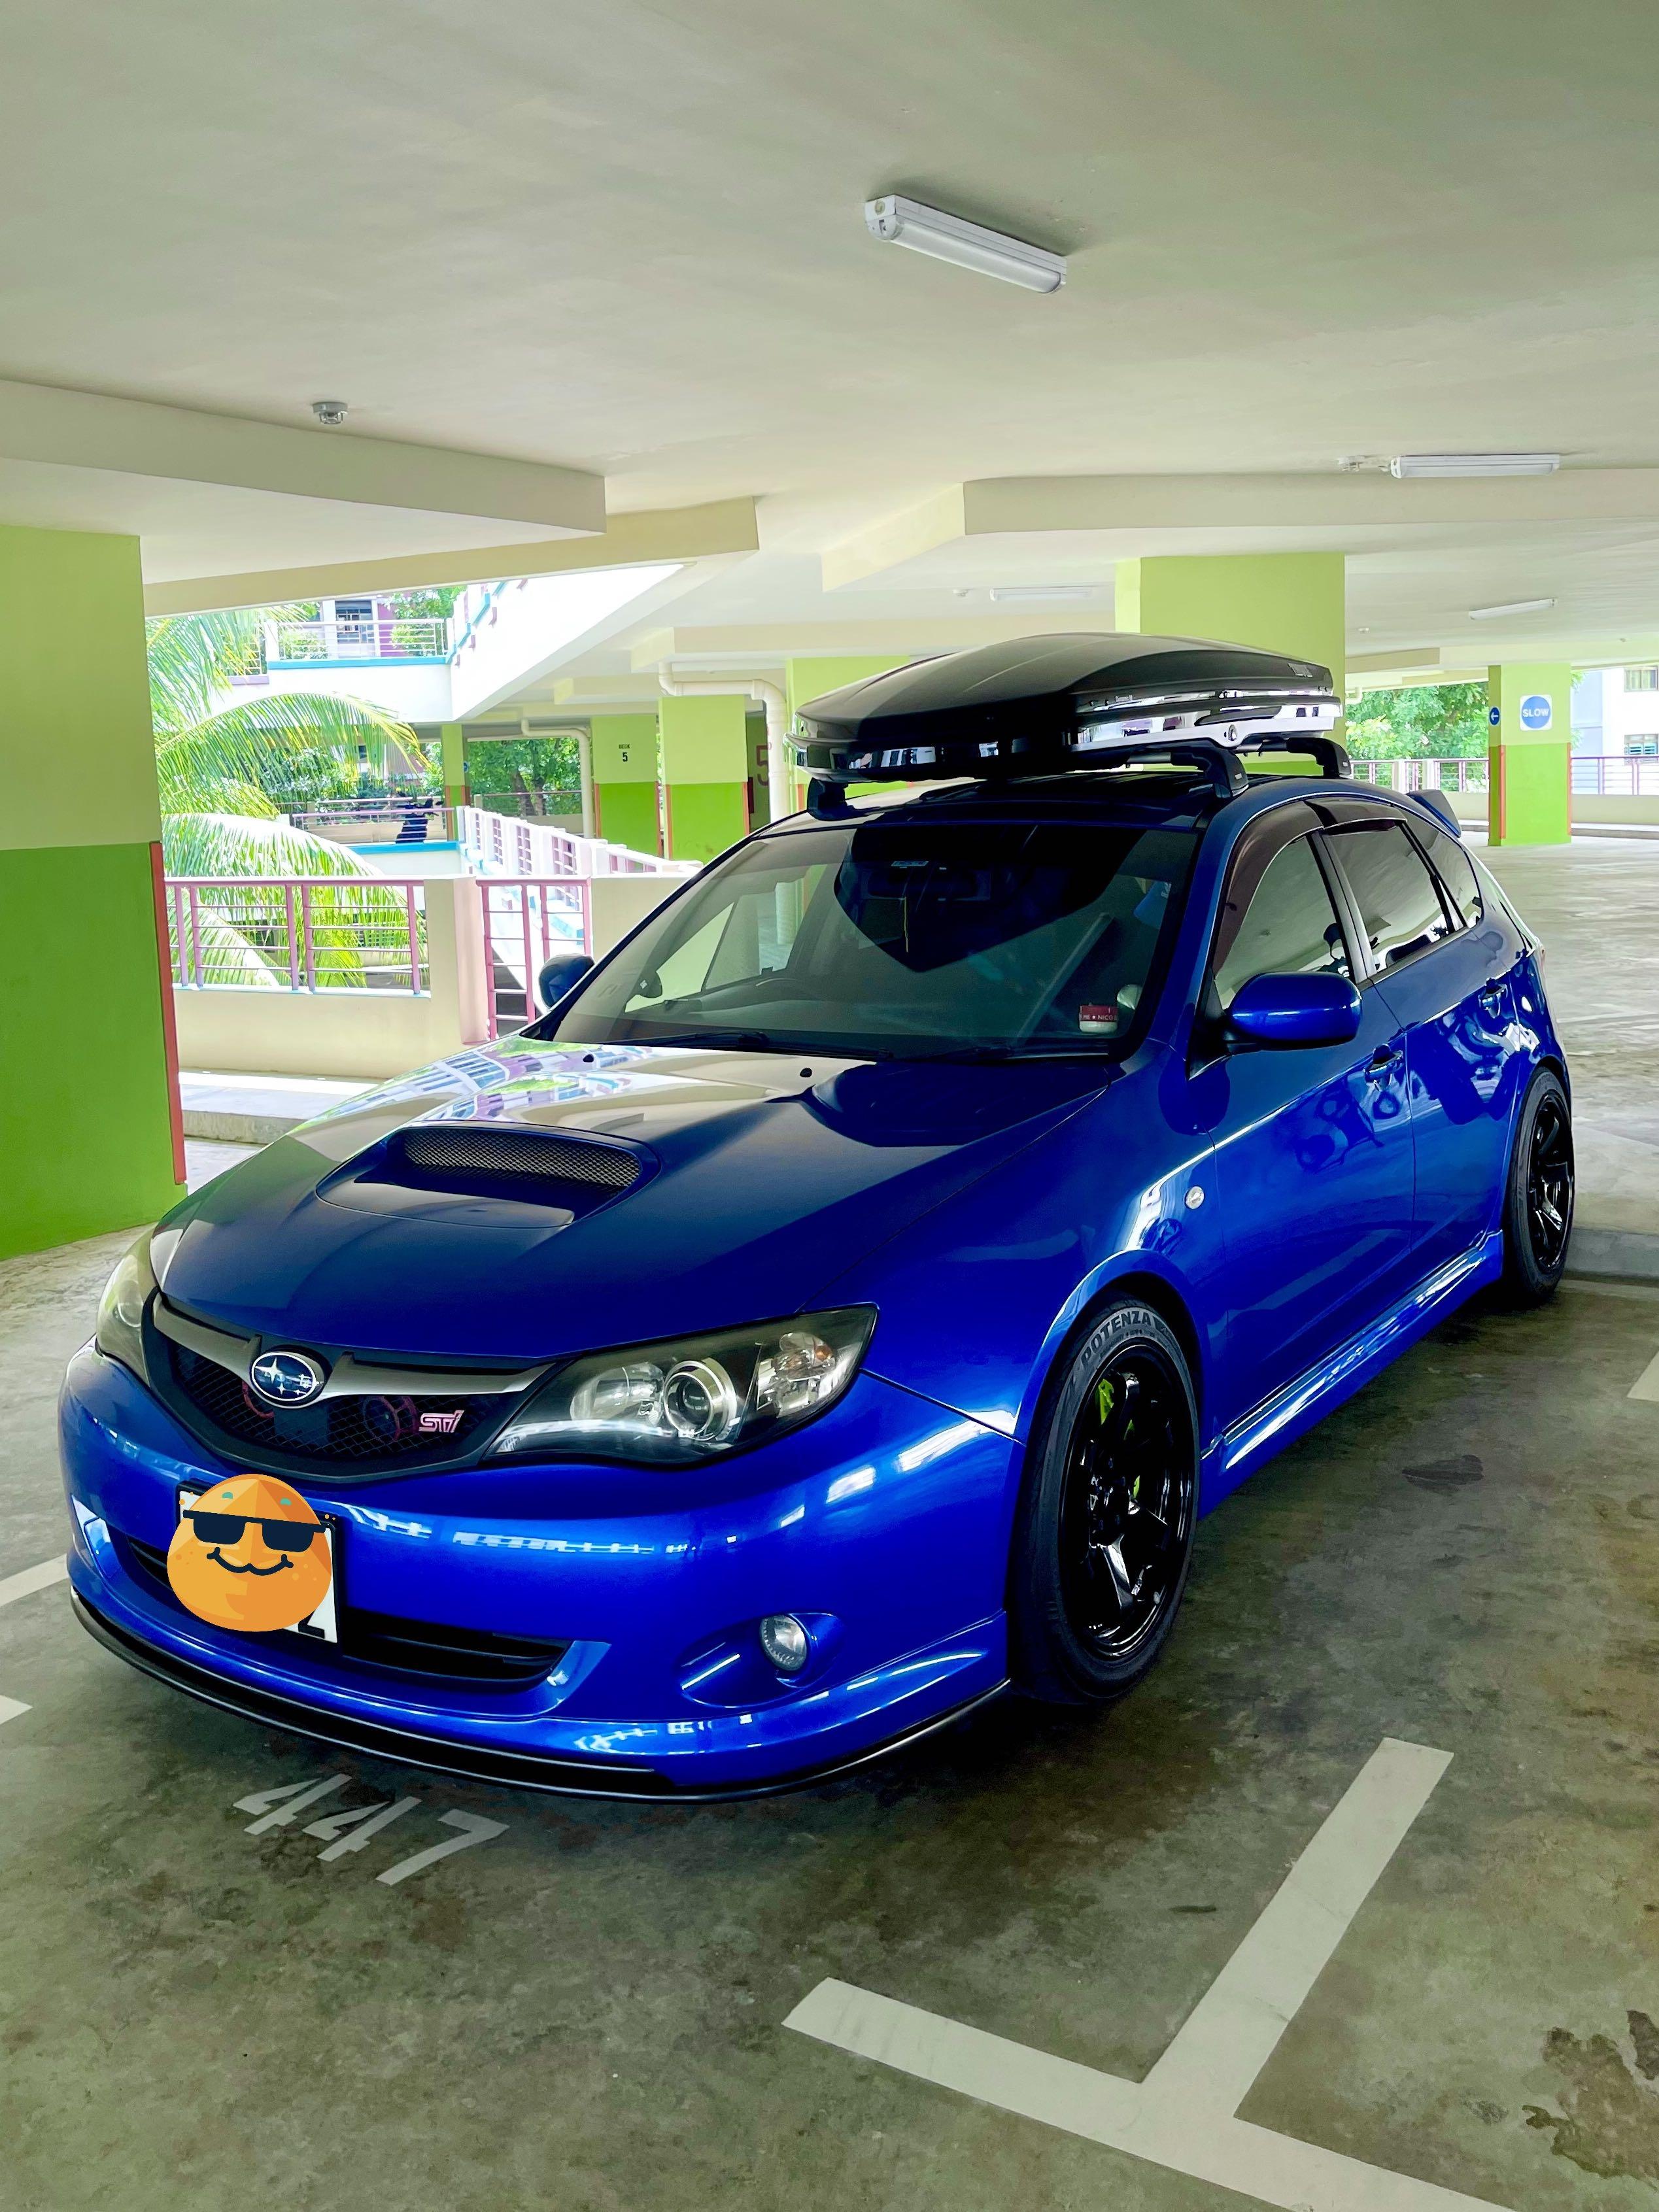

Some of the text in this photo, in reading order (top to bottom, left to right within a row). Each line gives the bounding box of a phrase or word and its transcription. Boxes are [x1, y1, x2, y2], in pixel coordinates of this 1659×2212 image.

[1522, 708, 1549, 717] SLOW
[622, 751, 628, 762] 5
[1081, 1310, 1152, 1368] POTENZA
[233, 1773, 510, 1885] 447
